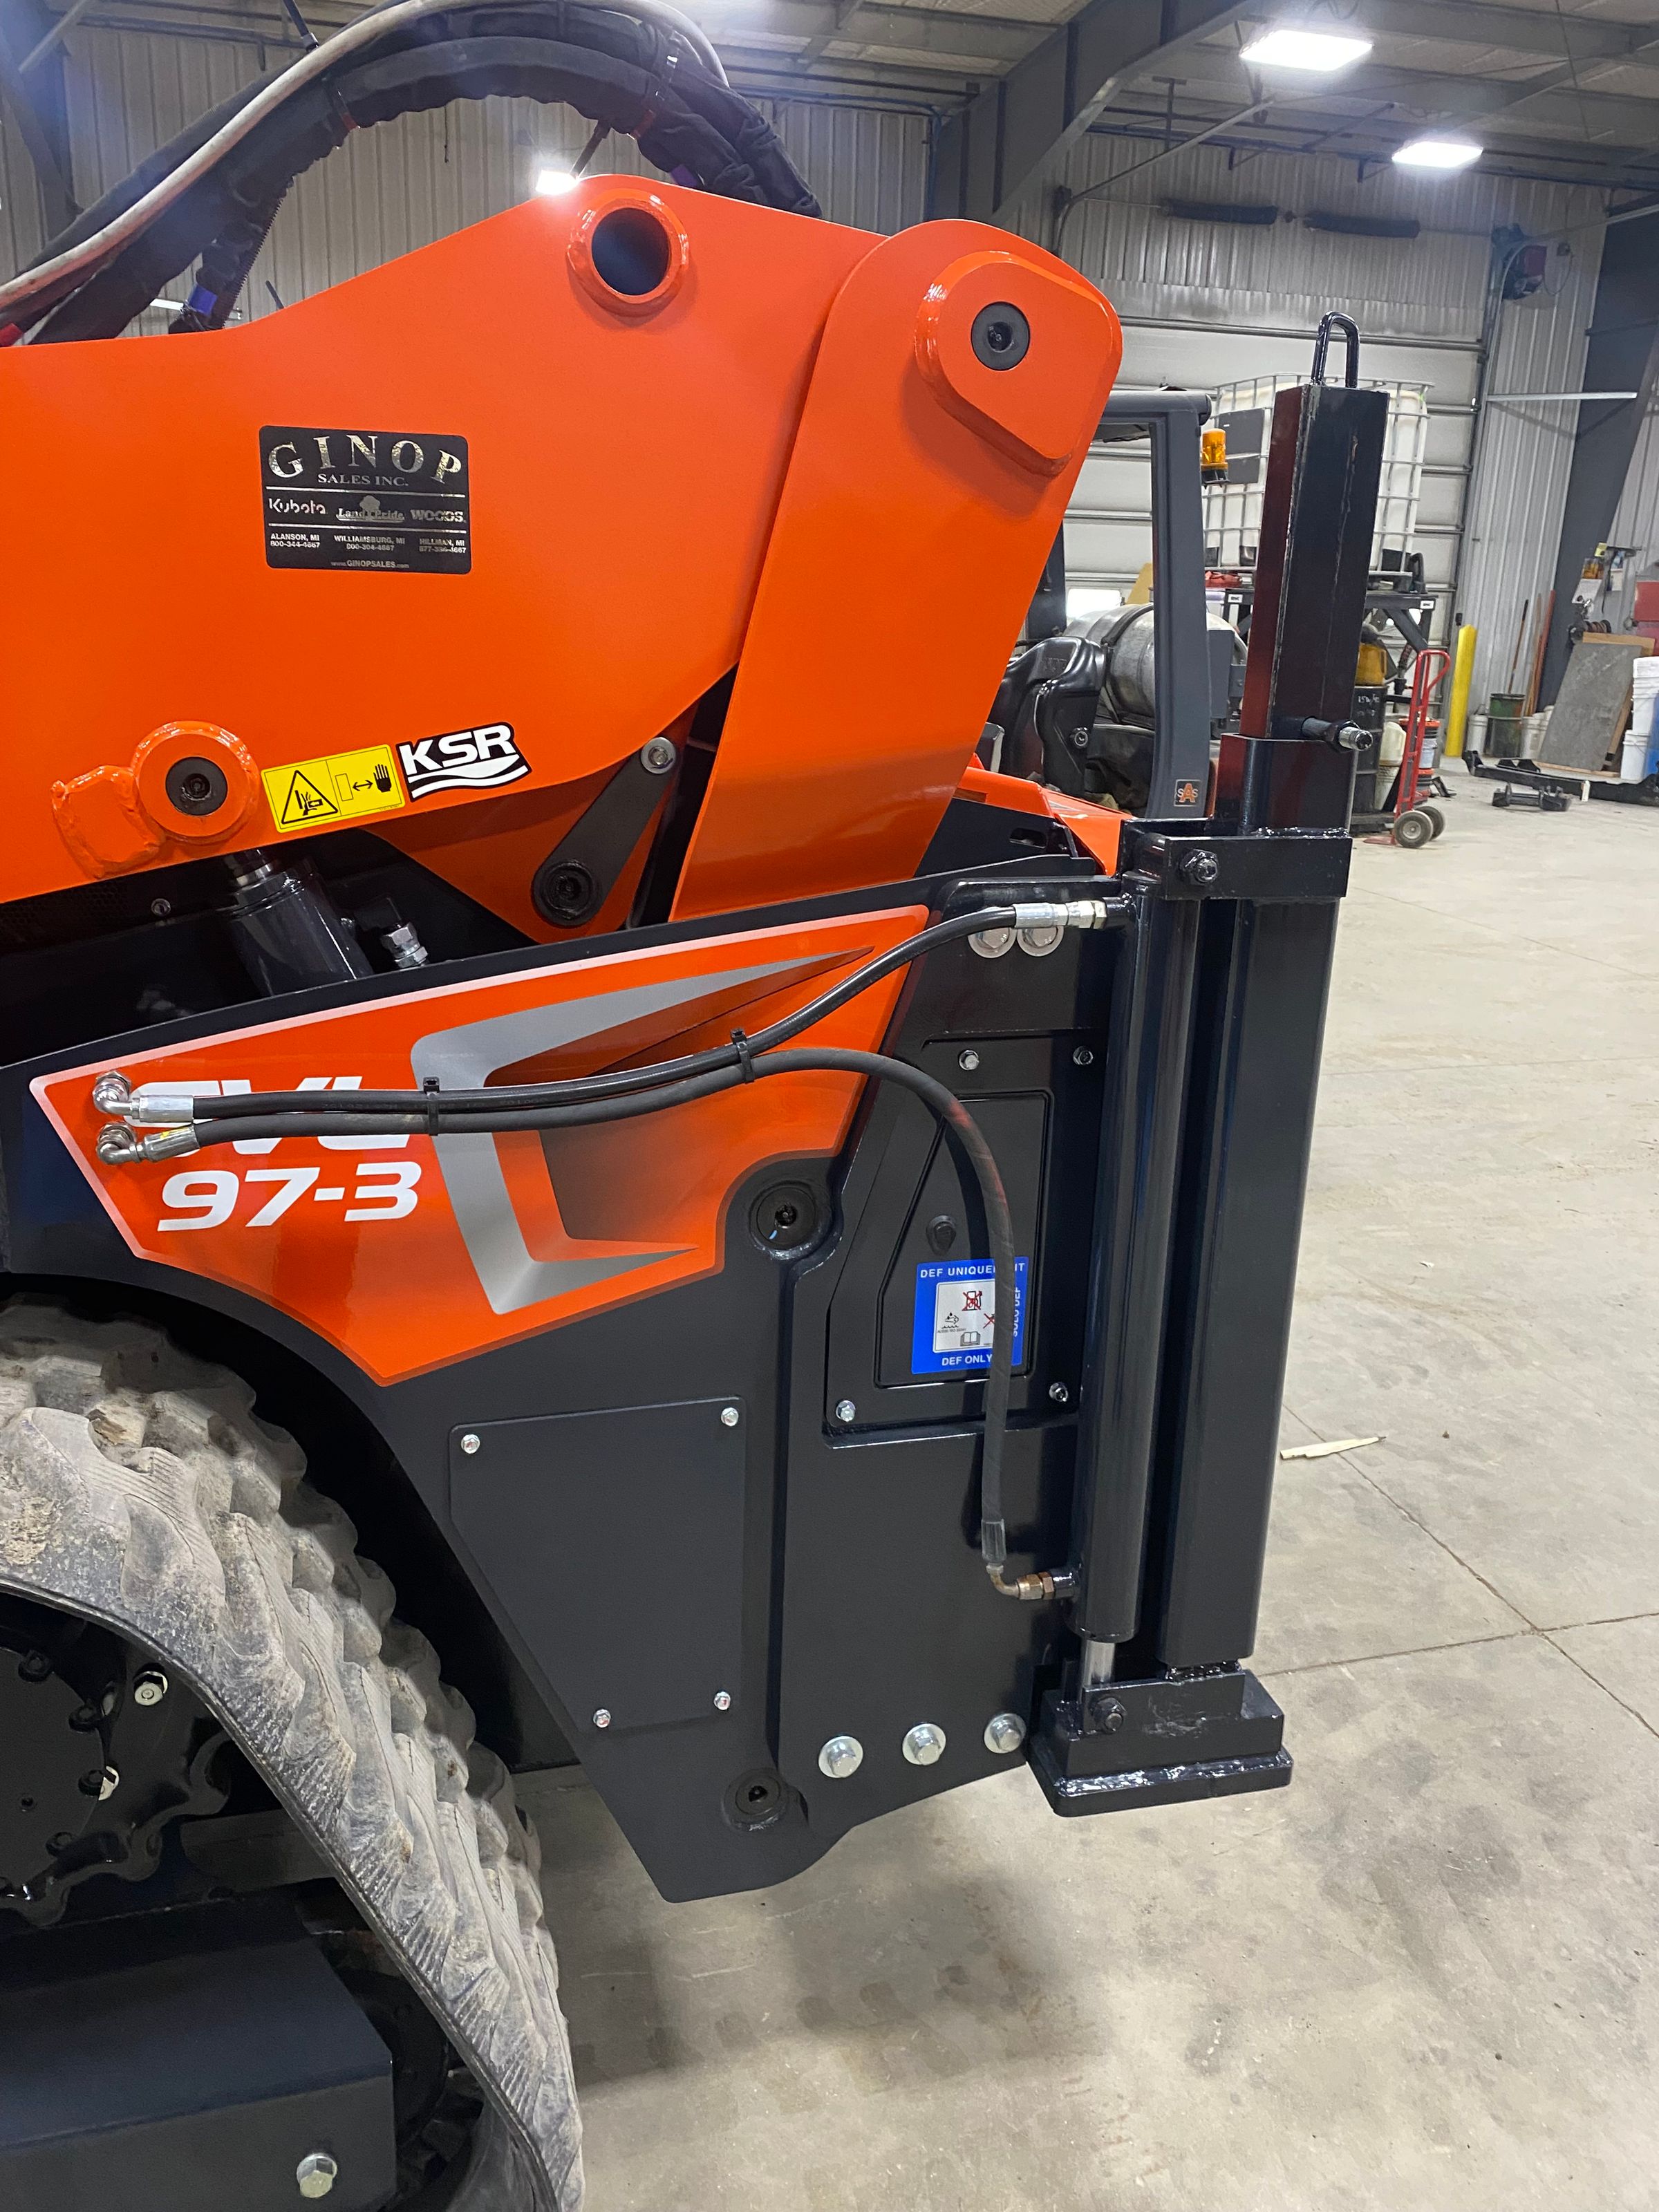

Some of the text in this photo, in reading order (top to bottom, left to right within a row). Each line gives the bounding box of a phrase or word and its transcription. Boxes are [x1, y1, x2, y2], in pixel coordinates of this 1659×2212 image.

[268, 434, 462, 484] GINOP
[318, 474, 409, 487] SALES INC.
[268, 498, 326, 515] Kubota
[338, 507, 404, 519] Land Pride
[270, 533, 309, 542] ALANSON,
[333, 535, 395, 544] WILLIAMSBURG,
[420, 538, 454, 547] HILLMAN,
[400, 724, 516, 775] KSR
[1177, 782, 1199, 803] SAS
[157, 1161, 422, 1232] 97-3
[920, 1268, 943, 1278] DEF
[941, 1353, 993, 1366] DEF ONLY
